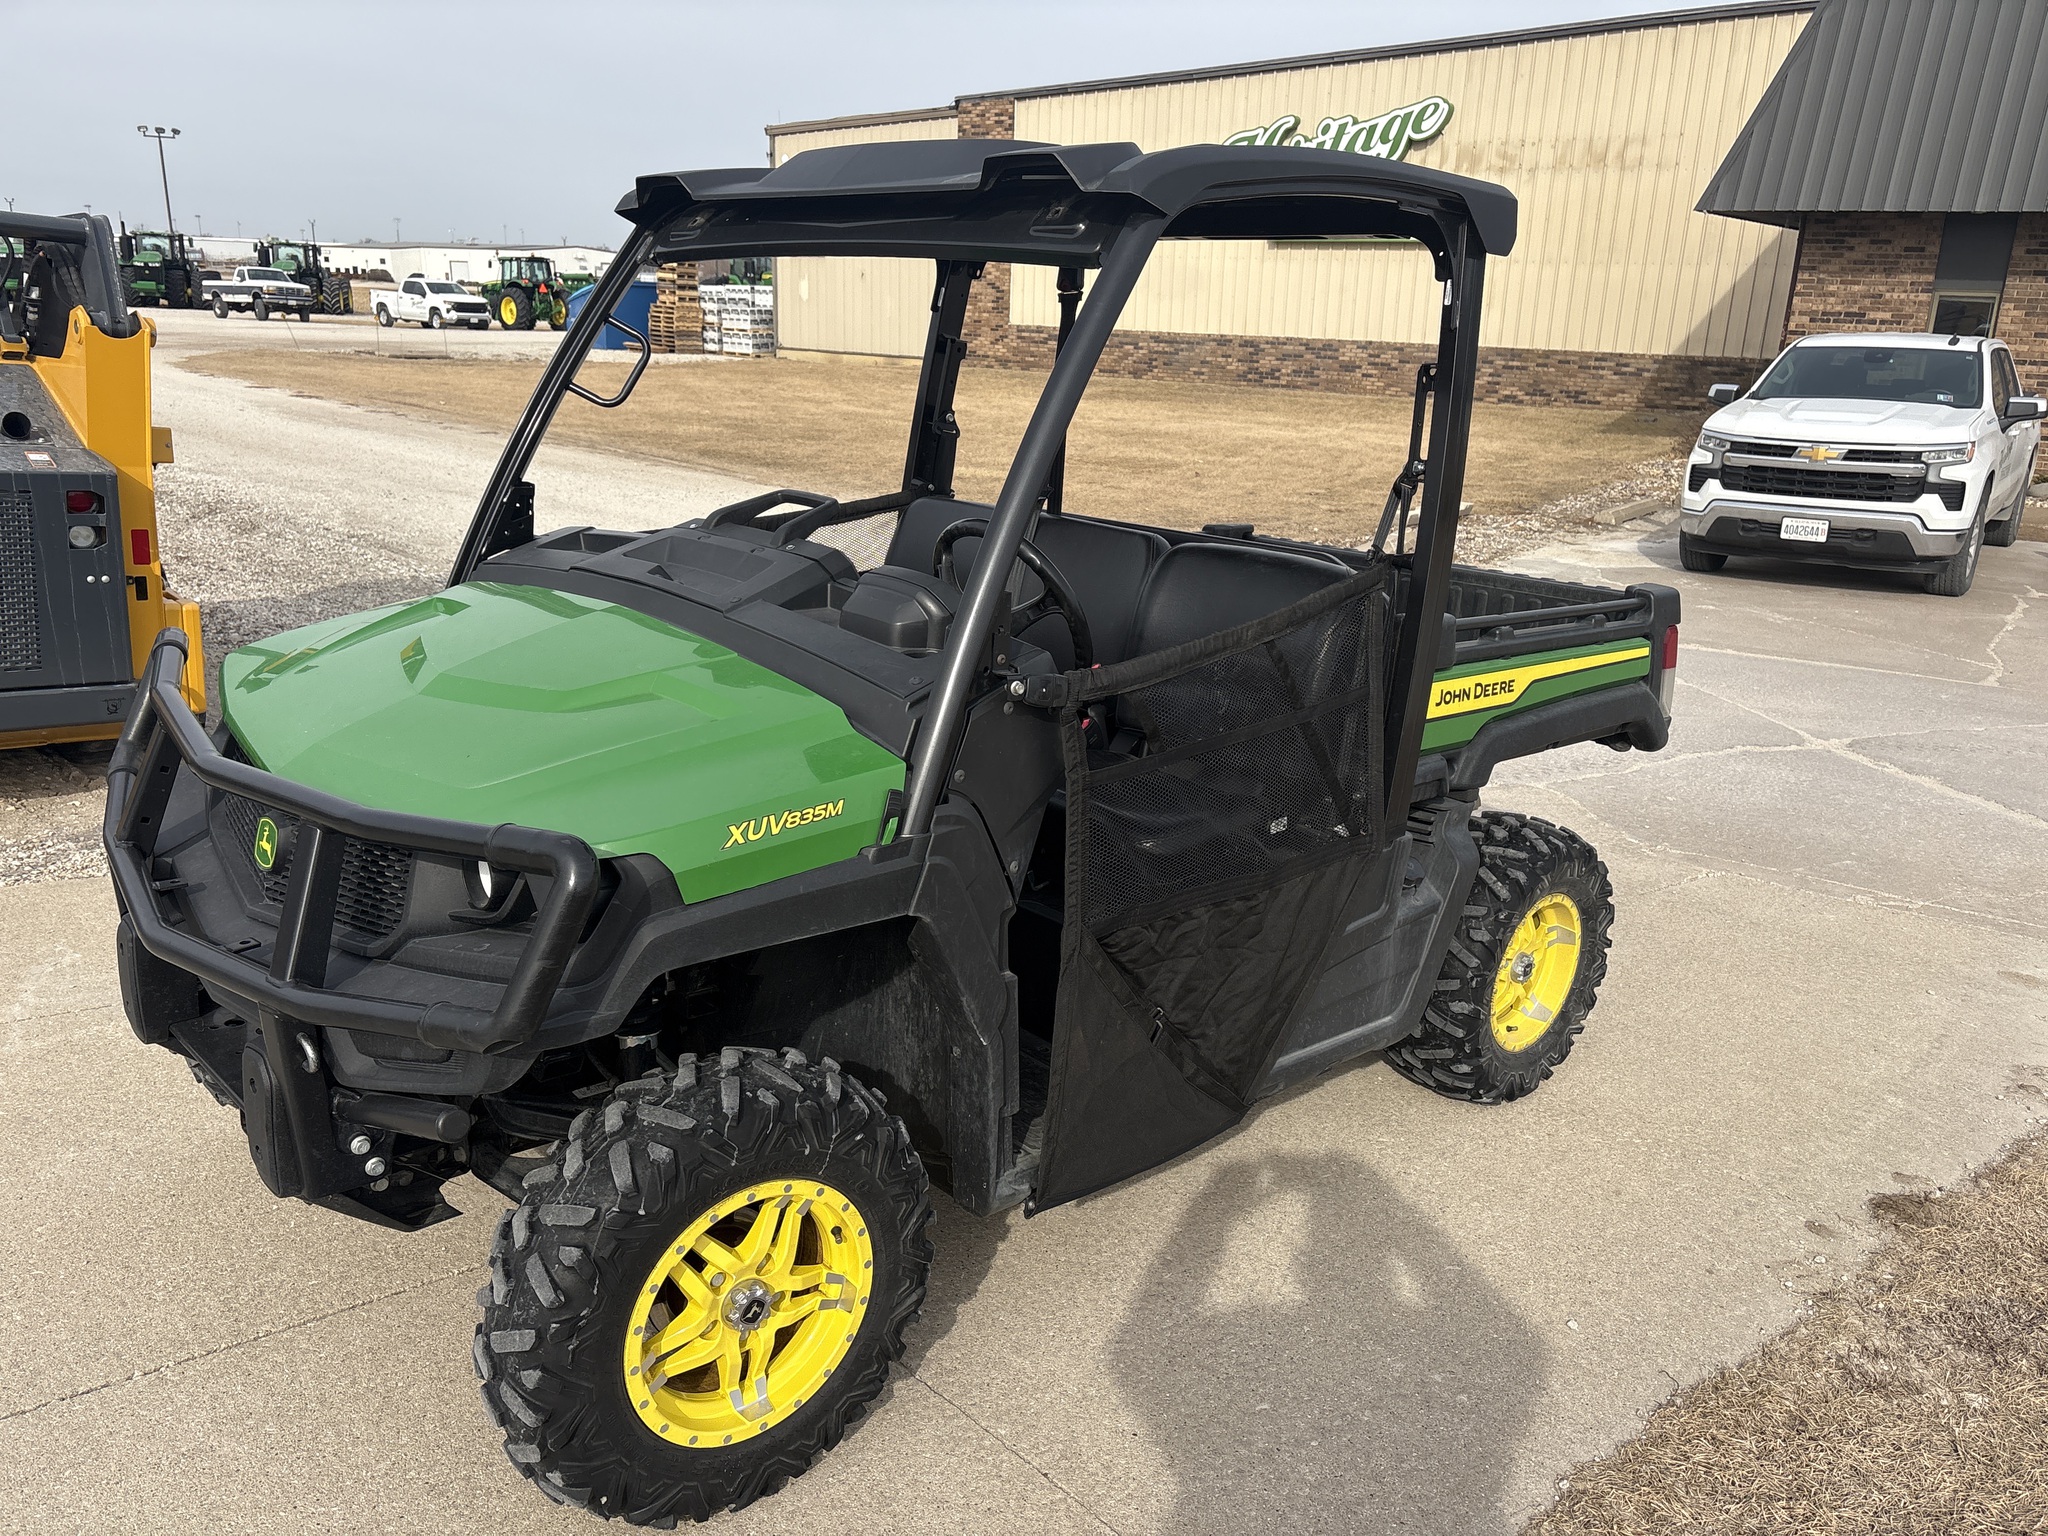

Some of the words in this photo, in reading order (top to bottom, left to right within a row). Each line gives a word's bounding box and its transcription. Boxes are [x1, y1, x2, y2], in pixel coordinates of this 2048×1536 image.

[1223, 97, 1452, 161] itage
[1783, 524, 1819, 537] 4042644
[1435, 687, 1471, 707] JOHN
[1473, 679, 1515, 700] DEERE
[721, 798, 845, 850] XUV835M
